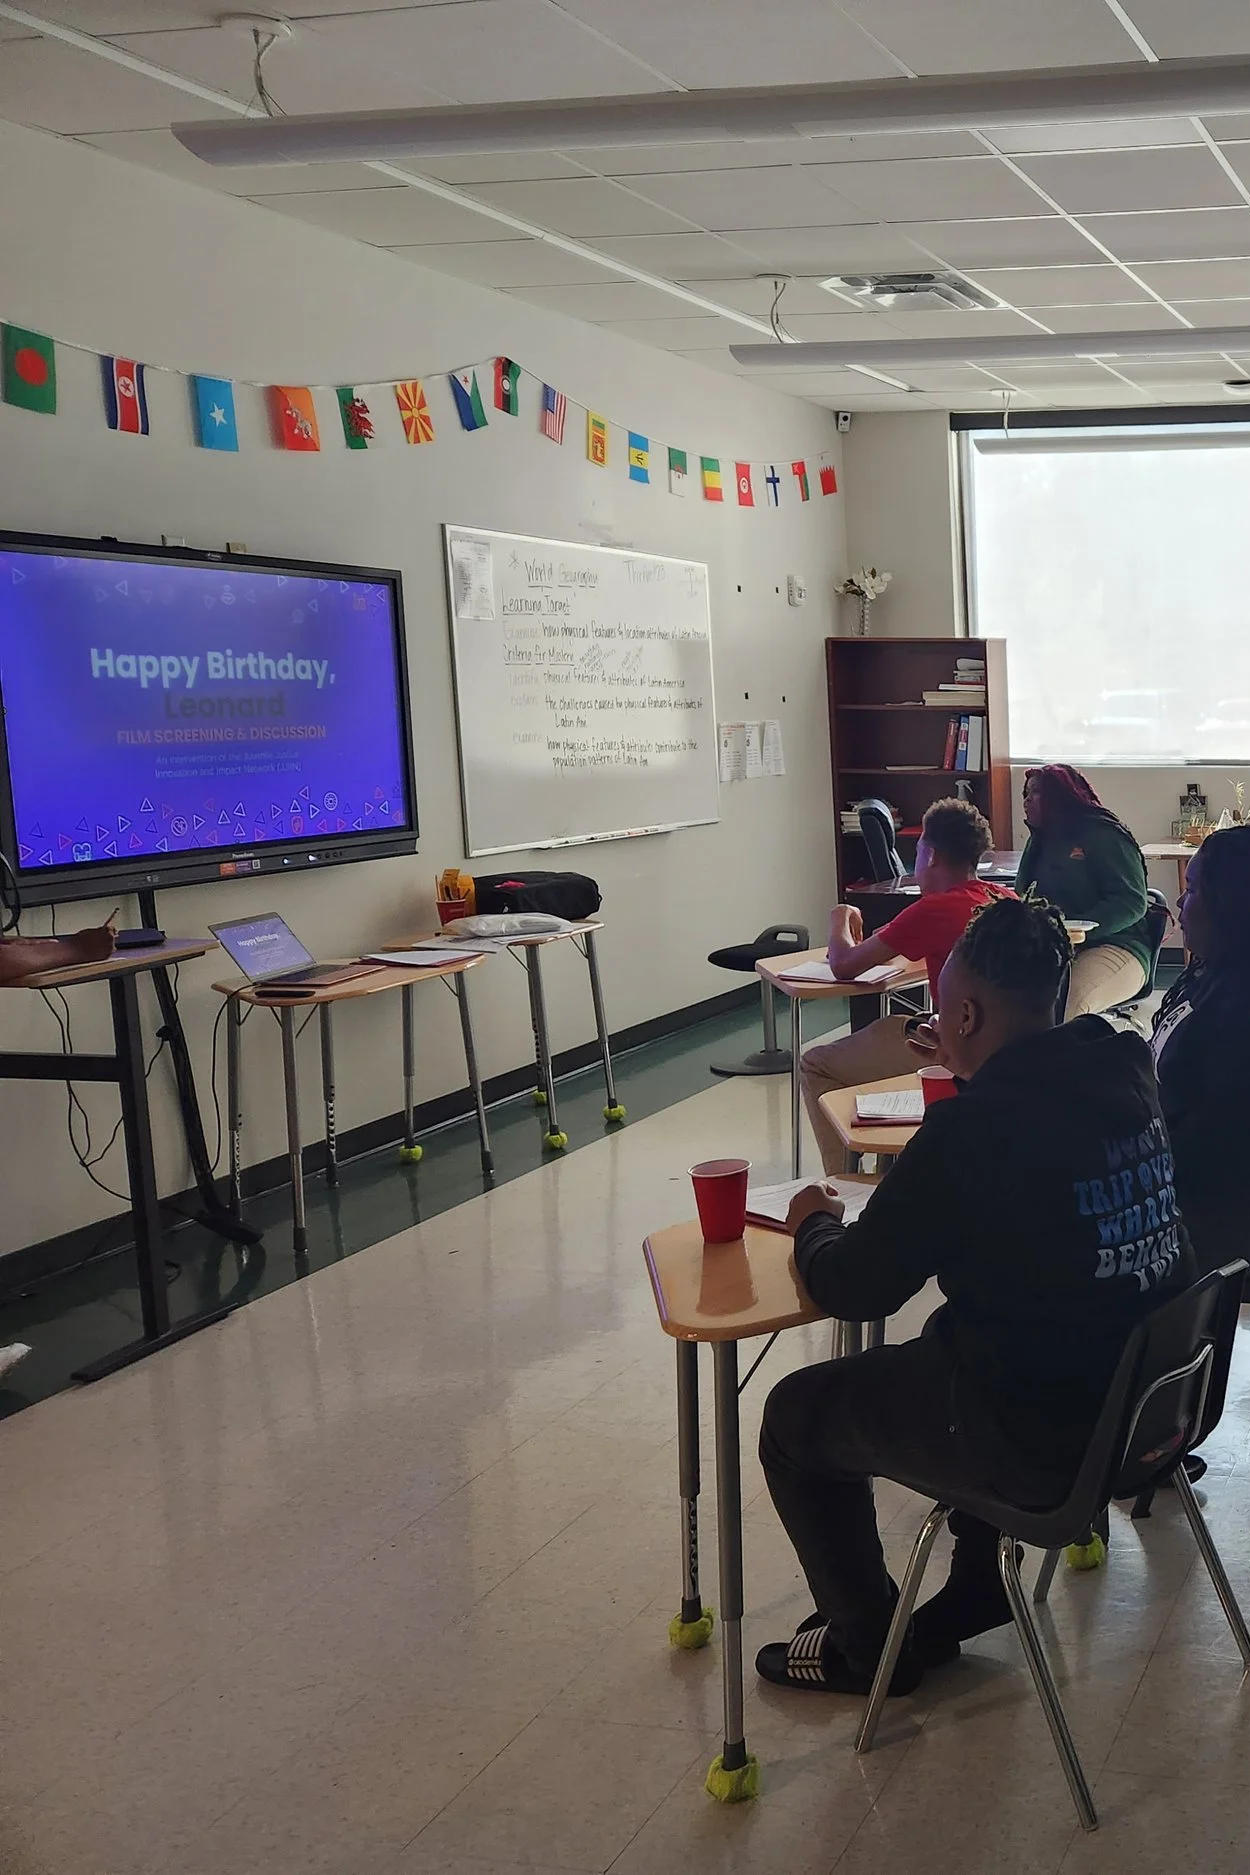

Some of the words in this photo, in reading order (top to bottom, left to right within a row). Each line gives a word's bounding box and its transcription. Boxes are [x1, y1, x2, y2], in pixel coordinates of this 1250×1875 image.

[523, 558, 553, 582] World
[502, 588, 541, 613] Learning
[541, 621, 559, 638] how
[90, 648, 200, 688] Happy
[206, 649, 336, 688] Birthday,
[164, 690, 286, 720] Leonard
[555, 712, 574, 728] Latin
[117, 730, 151, 745] FILM
[154, 727, 233, 744] SCREENING
[237, 728, 247, 740] &
[250, 725, 327, 740] DISCUSSION
[546, 736, 560, 750] how
[200, 767, 215, 776] and
[216, 765, 242, 777] Impact
[1074, 1169, 1133, 1216] TRIP
